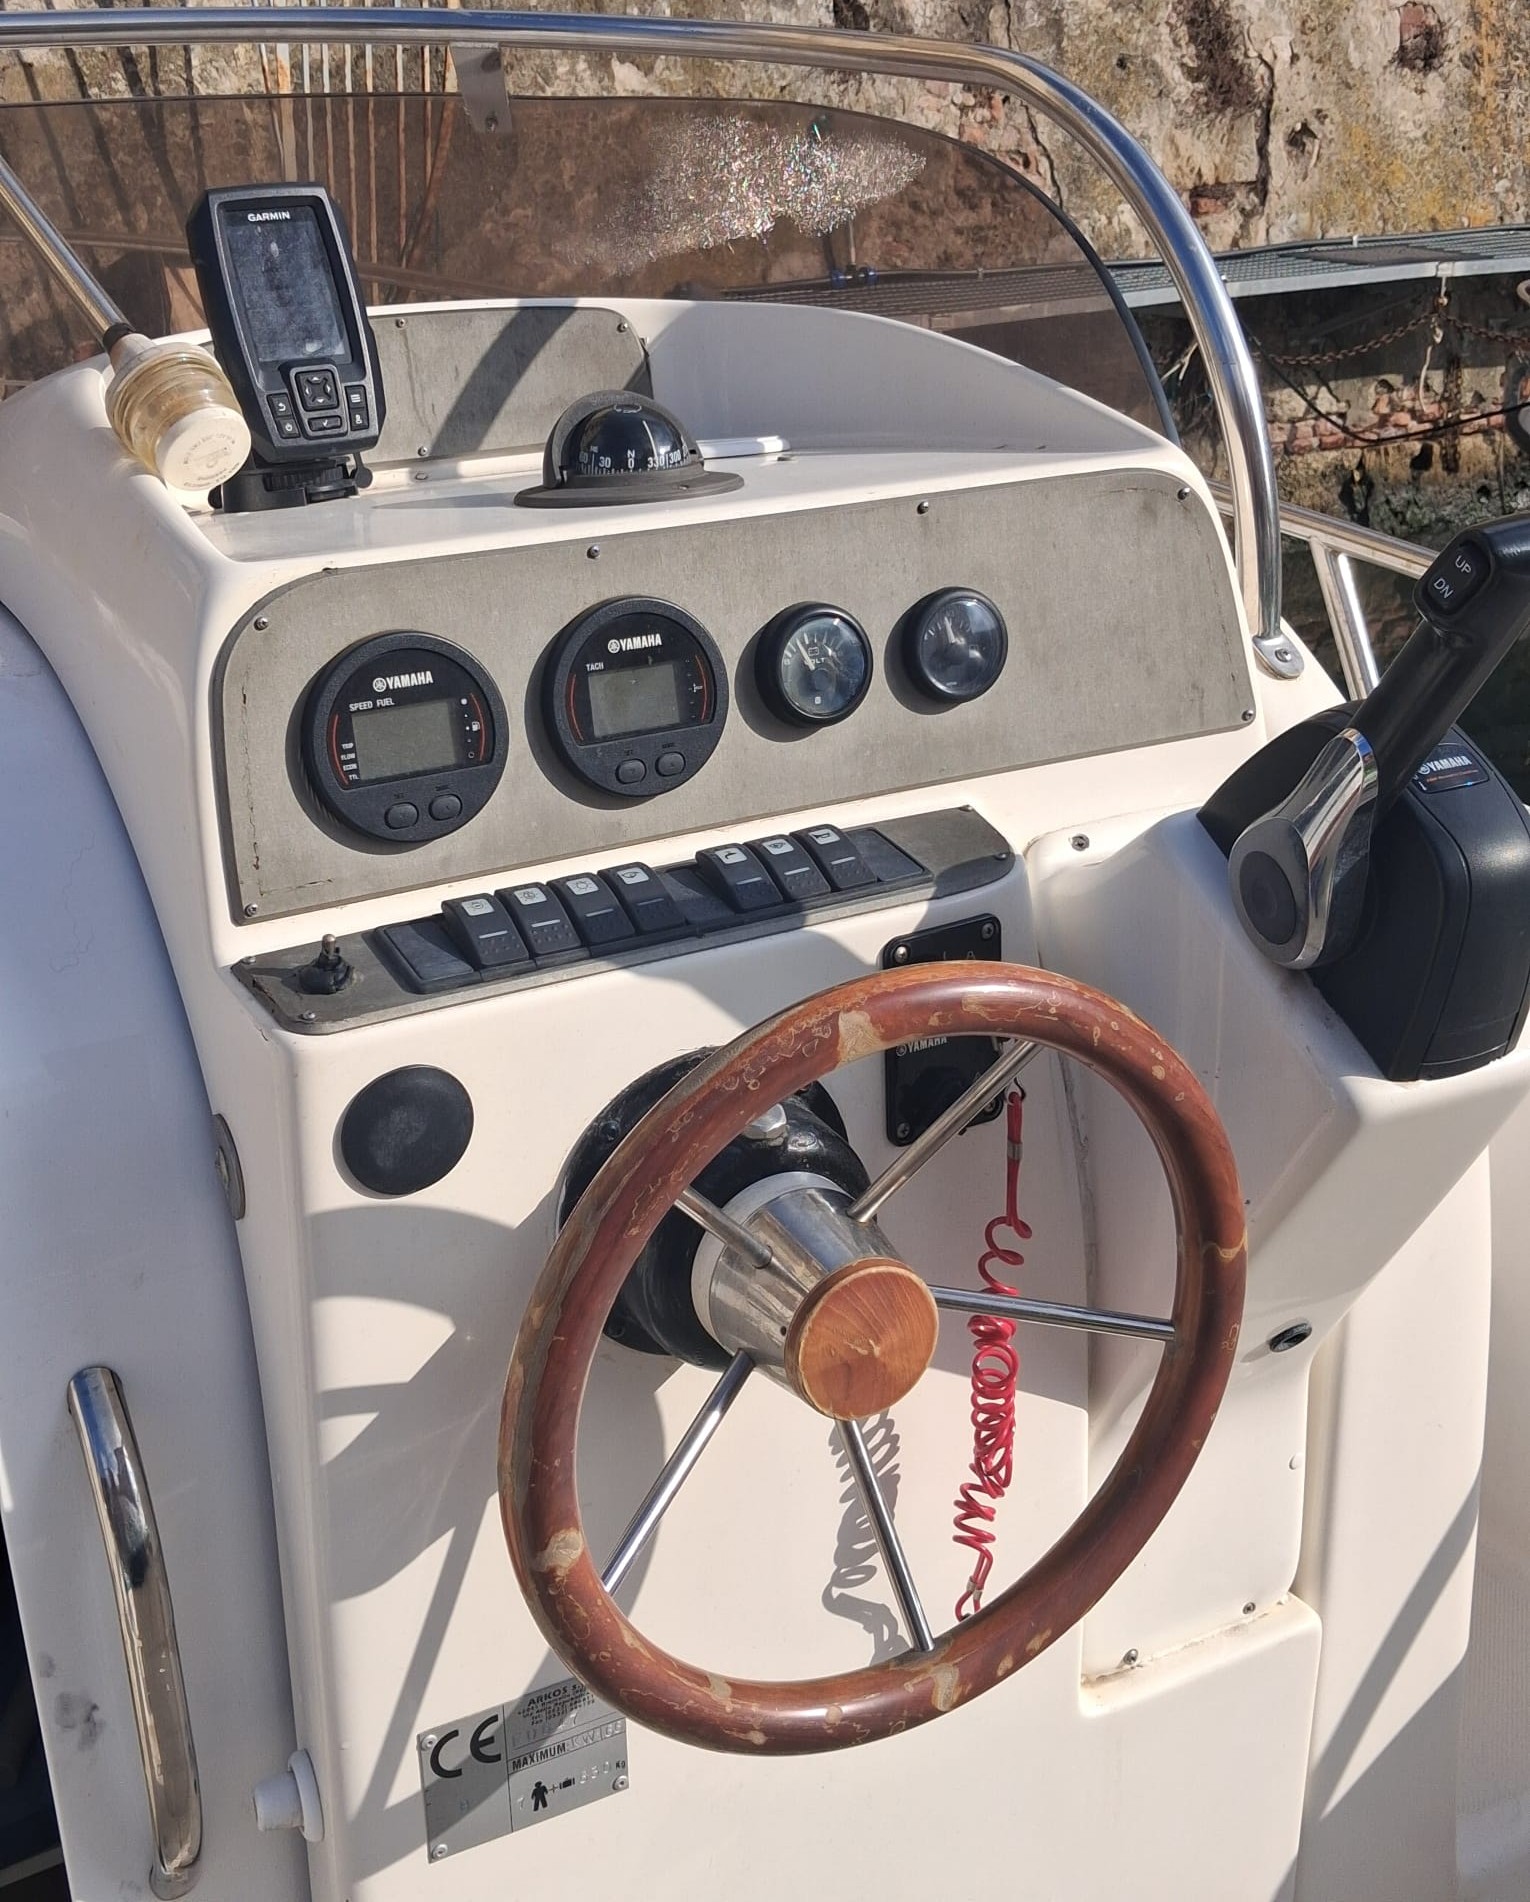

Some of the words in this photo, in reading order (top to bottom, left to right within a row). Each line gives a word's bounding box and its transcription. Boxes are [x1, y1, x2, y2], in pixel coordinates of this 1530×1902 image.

[247, 210, 291, 222] GARMIN
[599, 456, 612, 468] 30
[627, 449, 636, 458] N
[1454, 554, 1472, 576] UP
[1433, 577, 1454, 599] DN
[620, 633, 663, 652] YAMAHA
[586, 661, 604, 672] TACH
[386, 670, 434, 690] YAMAHA
[349, 700, 373, 712] SPEED
[376, 698, 396, 708] FUEL
[1426, 755, 1473, 772] YAMAHA
[907, 1036, 948, 1053] YAMAHA
[527, 1685, 568, 1707] ARKOS
[430, 1713, 502, 1779] CE
[512, 1742, 567, 1771] MAXIMUM
